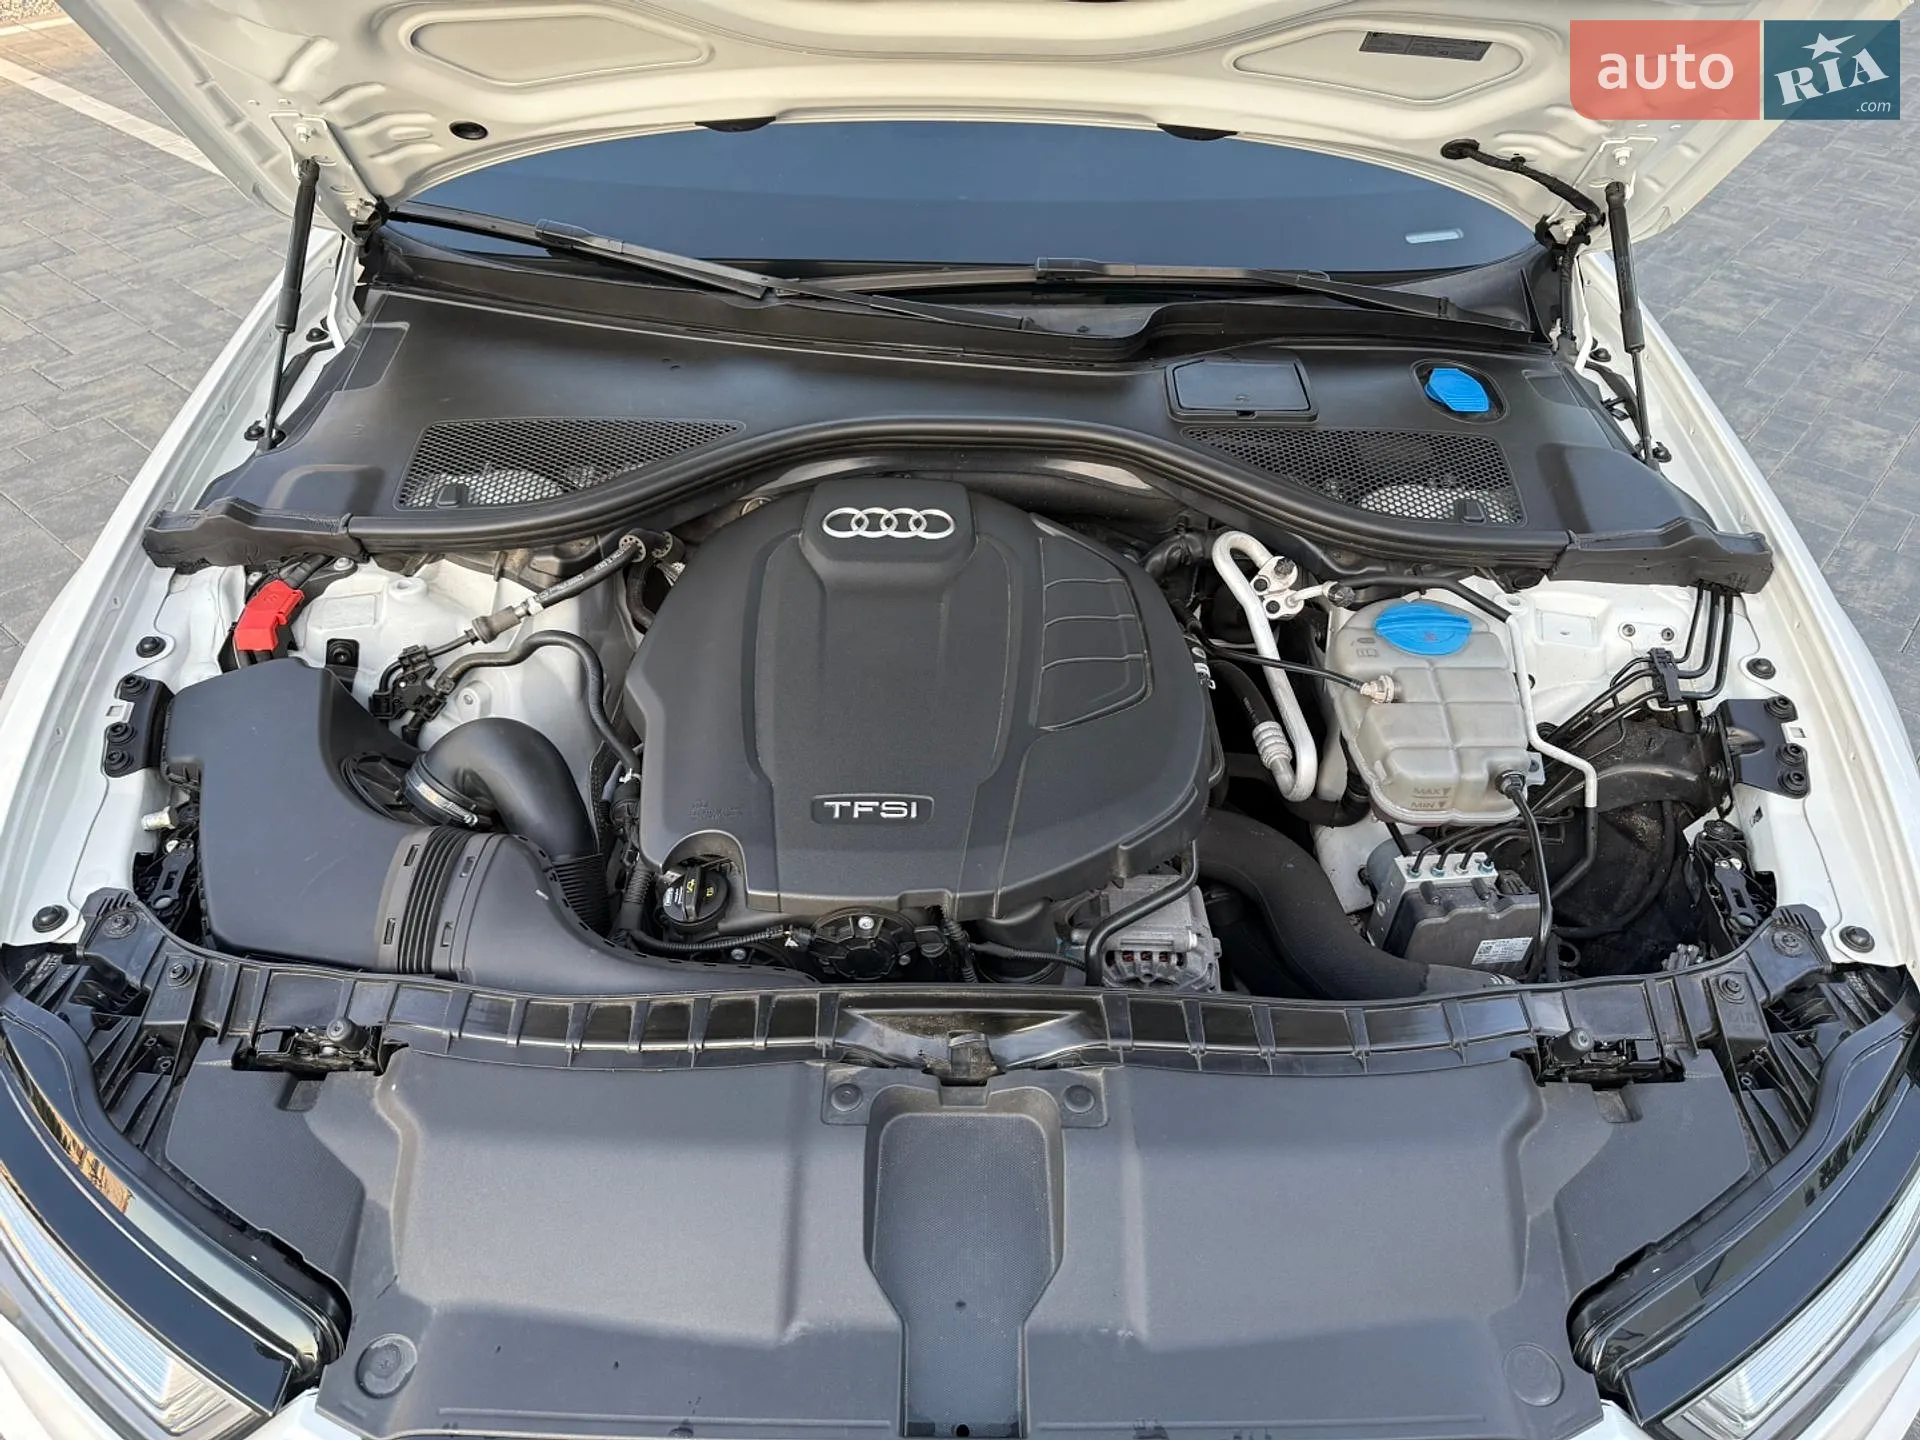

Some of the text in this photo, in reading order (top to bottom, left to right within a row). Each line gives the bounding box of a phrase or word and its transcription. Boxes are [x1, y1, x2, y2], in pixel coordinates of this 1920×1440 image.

[1413, 787, 1441, 795] MAX
[1411, 801, 1436, 809] MIN
[823, 801, 918, 819] TFSI
